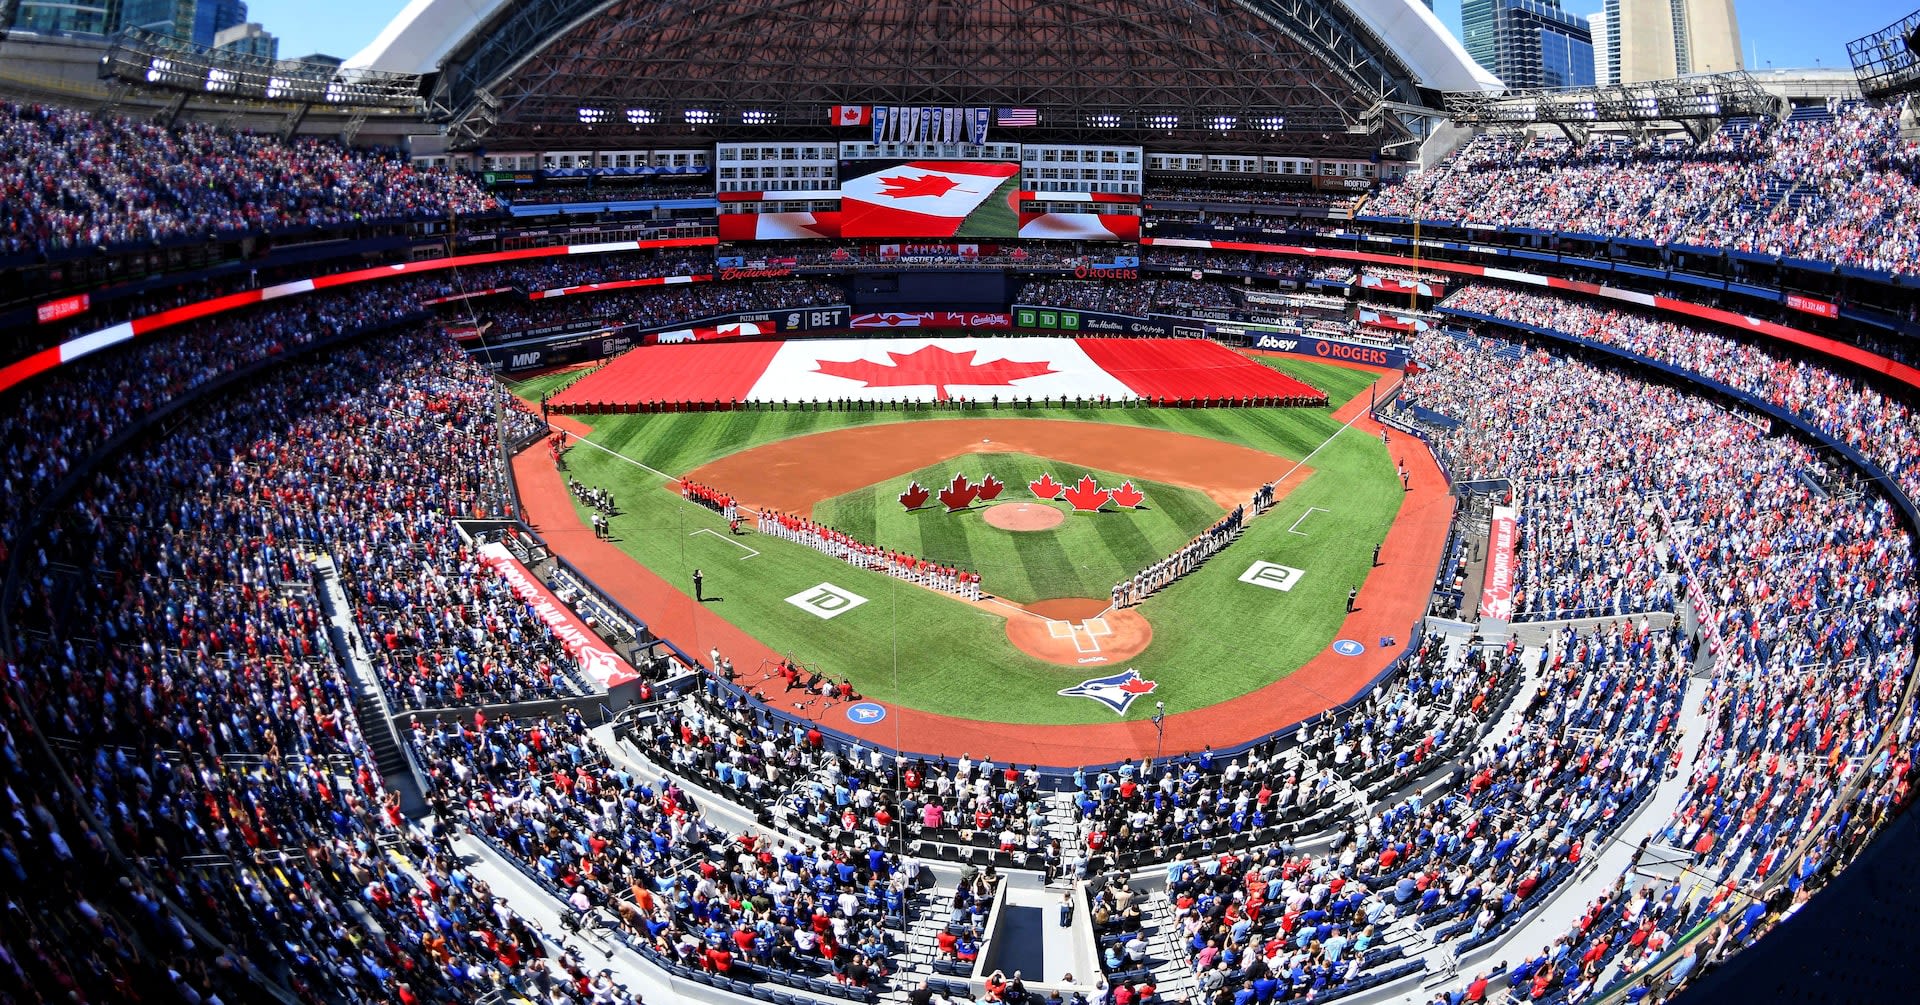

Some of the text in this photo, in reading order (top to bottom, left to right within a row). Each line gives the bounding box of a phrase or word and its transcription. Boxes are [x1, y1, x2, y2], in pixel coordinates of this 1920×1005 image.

[1344, 180, 1370, 188] ROOFTOP
[905, 245, 952, 255] CANADA
[719, 268, 793, 280] Budweiser
[1090, 269, 1137, 279] ROGERS
[1248, 295, 1284, 305] theScore
[1290, 298, 1304, 307] BET
[811, 311, 841, 327] BET
[1020, 313, 1035, 324] TD
[1041, 314, 1056, 325] TD
[1063, 315, 1077, 326] TD
[1192, 310, 1230, 320] BLEACHERS
[1087, 320, 1122, 330] Tim Hortons
[1250, 316, 1280, 324] CANADA
[1281, 318, 1296, 327] DRY
[1141, 325, 1165, 334] Kubota
[1257, 335, 1297, 351] Sobeys
[512, 352, 540, 367] MNP
[1333, 346, 1386, 364] ROGERS
[1251, 566, 1290, 583] TD
[1493, 554, 1510, 588] TORONTO
[496, 560, 538, 598] TORONTO
[554, 624, 591, 646] JAYS
[806, 588, 850, 610] TD
